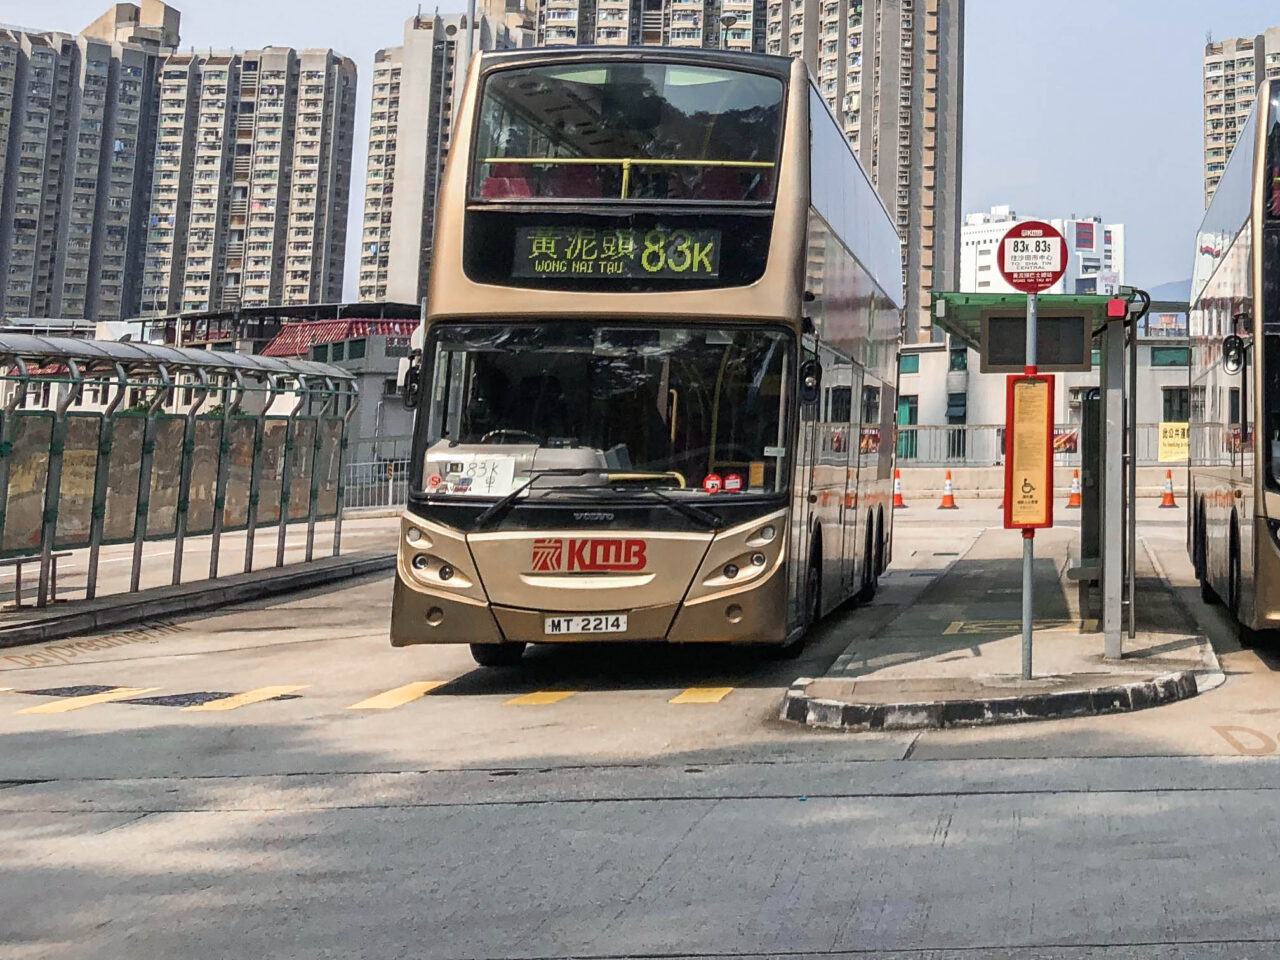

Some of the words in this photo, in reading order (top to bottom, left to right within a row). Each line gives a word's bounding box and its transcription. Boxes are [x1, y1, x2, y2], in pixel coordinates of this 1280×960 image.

[527, 228, 634, 260] 黃泥頭
[641, 230, 714, 273] 83K
[535, 261, 568, 273] WONG
[572, 261, 593, 273] NAI
[599, 261, 623, 273] TAU
[567, 538, 647, 572] KMB
[550, 618, 574, 633] MT
[580, 616, 621, 632] 2214
